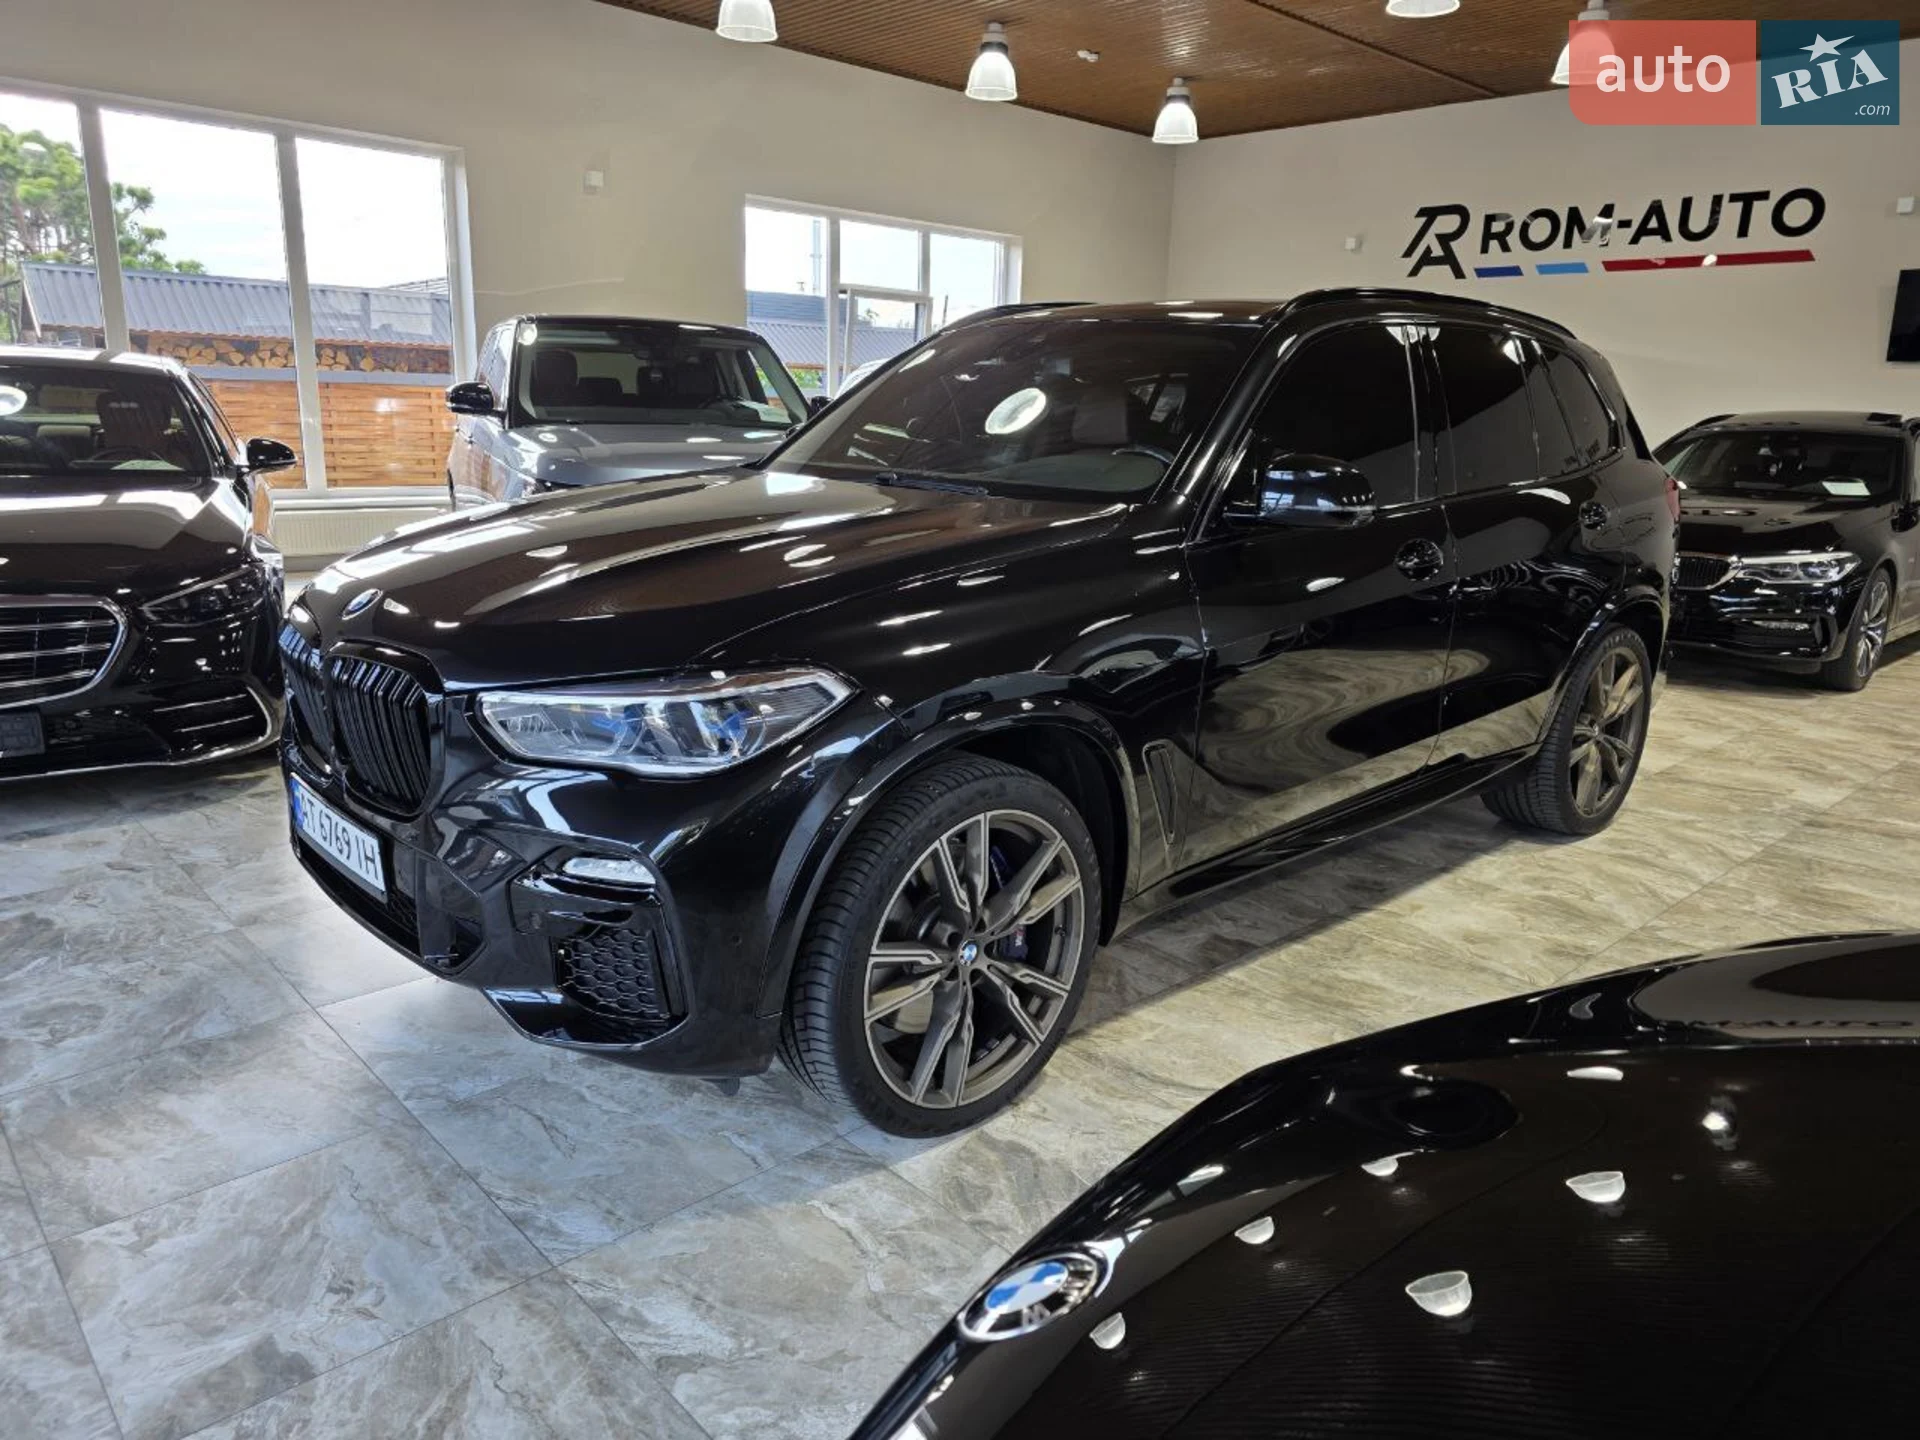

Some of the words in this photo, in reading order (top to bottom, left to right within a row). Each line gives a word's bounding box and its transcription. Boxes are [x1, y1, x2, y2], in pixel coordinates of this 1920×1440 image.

[1480, 187, 1826, 255] ROM-AUTO
[319, 809, 351, 861] 6769
[355, 835, 379, 881] IH
